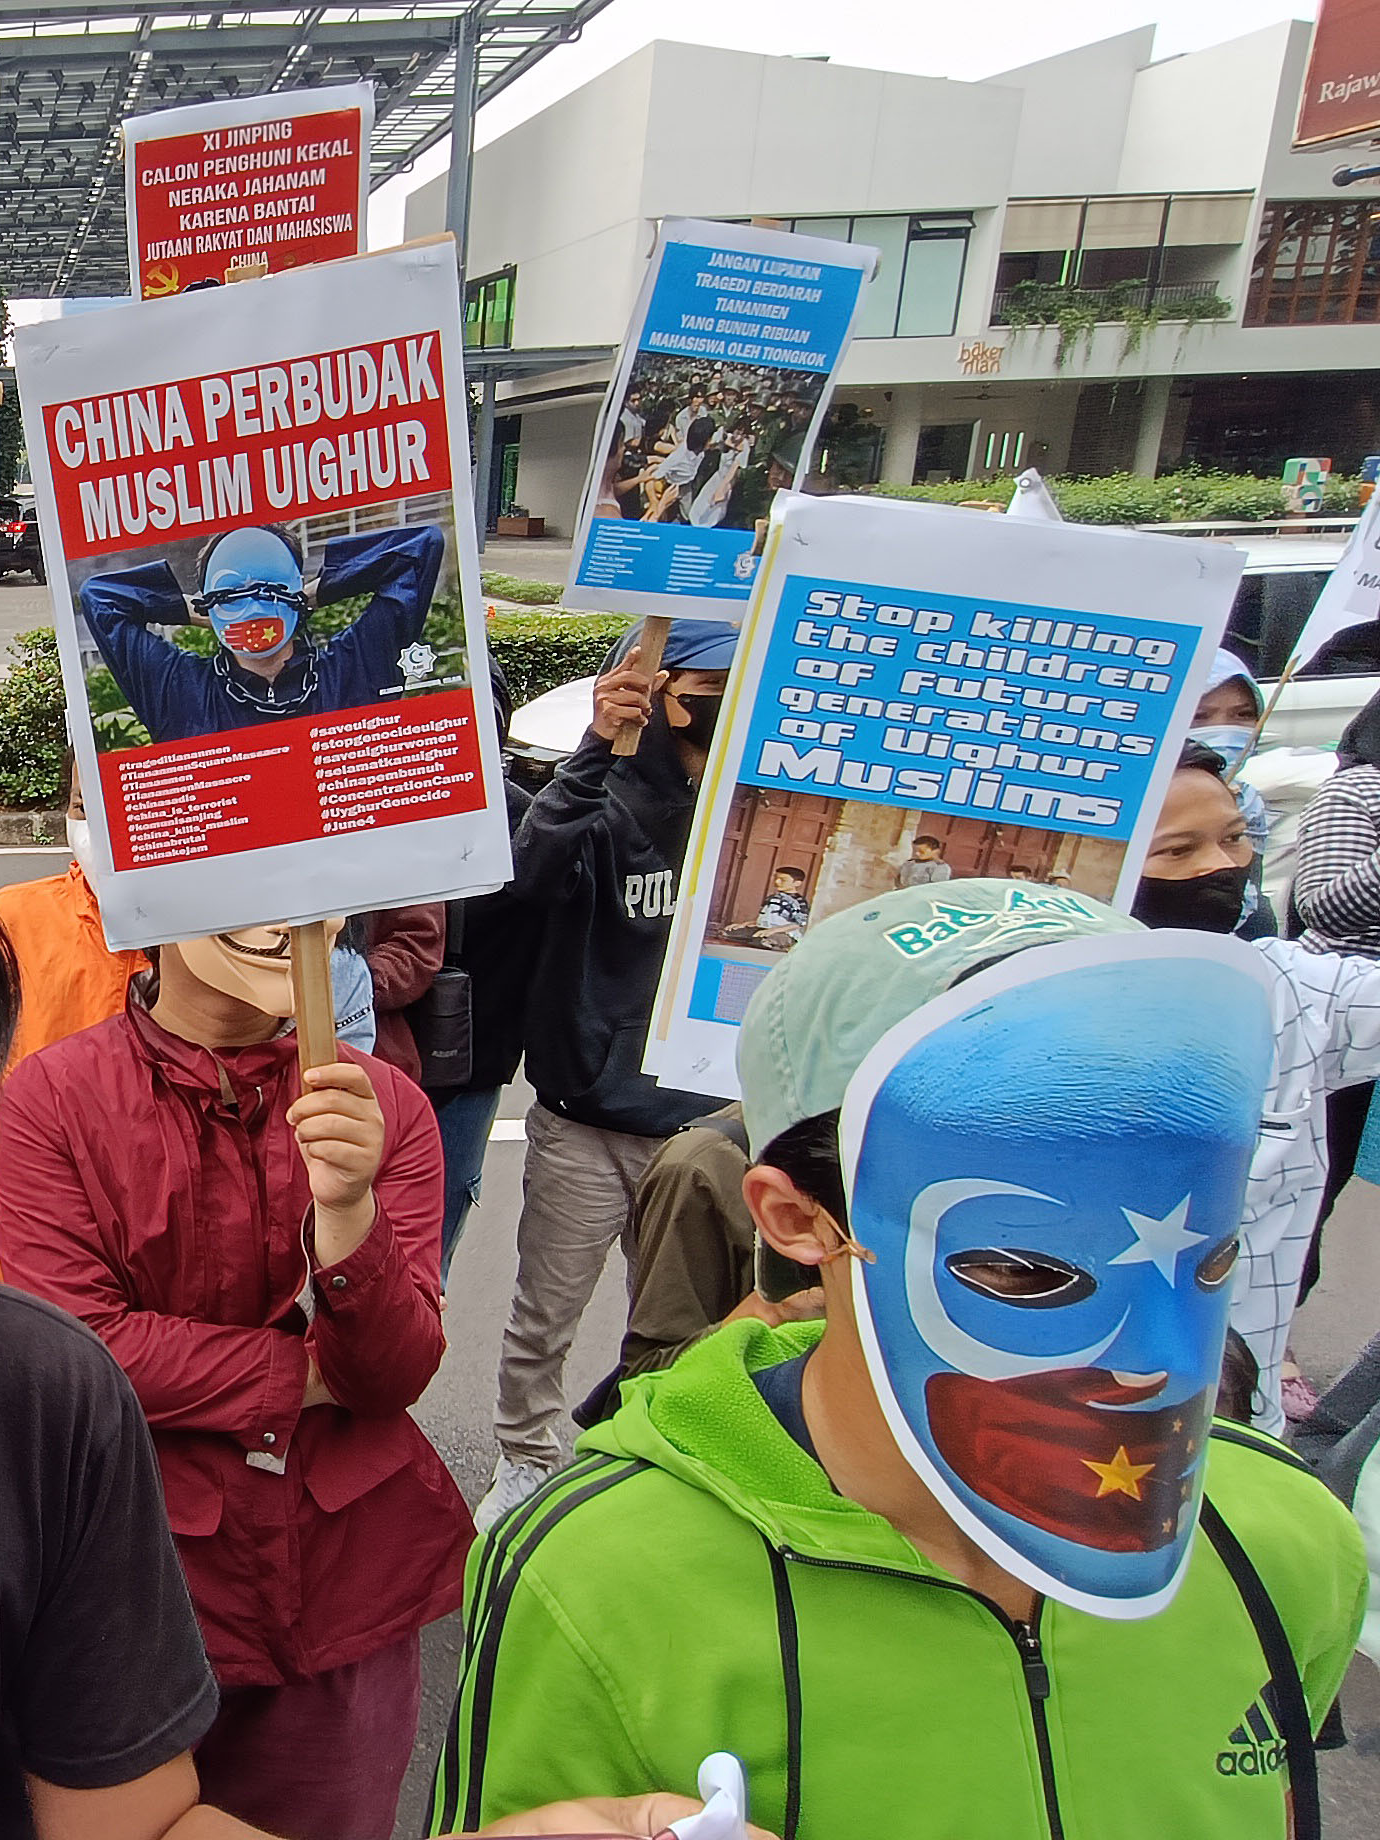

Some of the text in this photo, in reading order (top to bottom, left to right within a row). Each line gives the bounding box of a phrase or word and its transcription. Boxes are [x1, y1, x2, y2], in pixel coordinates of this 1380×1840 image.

[203, 121, 293, 152] XI JINPING
[142, 138, 353, 187] CALON PENGHUNI KEKAL
[168, 168, 326, 208] NERAKA JAHANAM
[179, 195, 315, 232] KARENA BANTAI
[145, 213, 353, 262] JUTAAN RAKYAT DAN MAHASISWA
[230, 251, 268, 270] CHINA
[707, 252, 822, 281] JANGAN LUPAKAN
[695, 272, 823, 303] TRAGEDI BERDARAH
[715, 297, 790, 320] TIANANMEN
[680, 314, 811, 345] YANG BUNUH RIBUAN
[649, 331, 827, 367] MAHASISWA OLEH TIONGKOK
[957, 341, 1004, 363] baker
[54, 335, 440, 469] CHINA PERBUDAK
[78, 419, 430, 544] MUSLIM UIGHUR
[805, 590, 1177, 667] Stop killing
[794, 620, 1172, 694] the children
[794, 657, 876, 687] of
[310, 714, 401, 738] #saveuighur
[312, 716, 469, 752] #stopgenocideuighur
[778, 717, 856, 747] of
[779, 685, 1156, 757] generations
[314, 733, 457, 765] #saveuighurwomen
[316, 746, 459, 779] #selamatkanuighur
[318, 762, 445, 793] #chinapembunuh
[320, 771, 474, 806] #ConcentrationCamp
[757, 740, 1123, 826] Muslims
[321, 790, 451, 819] #UyghurGenocide
[323, 815, 376, 833] #June4
[131, 834, 206, 853] #chinabrutal
